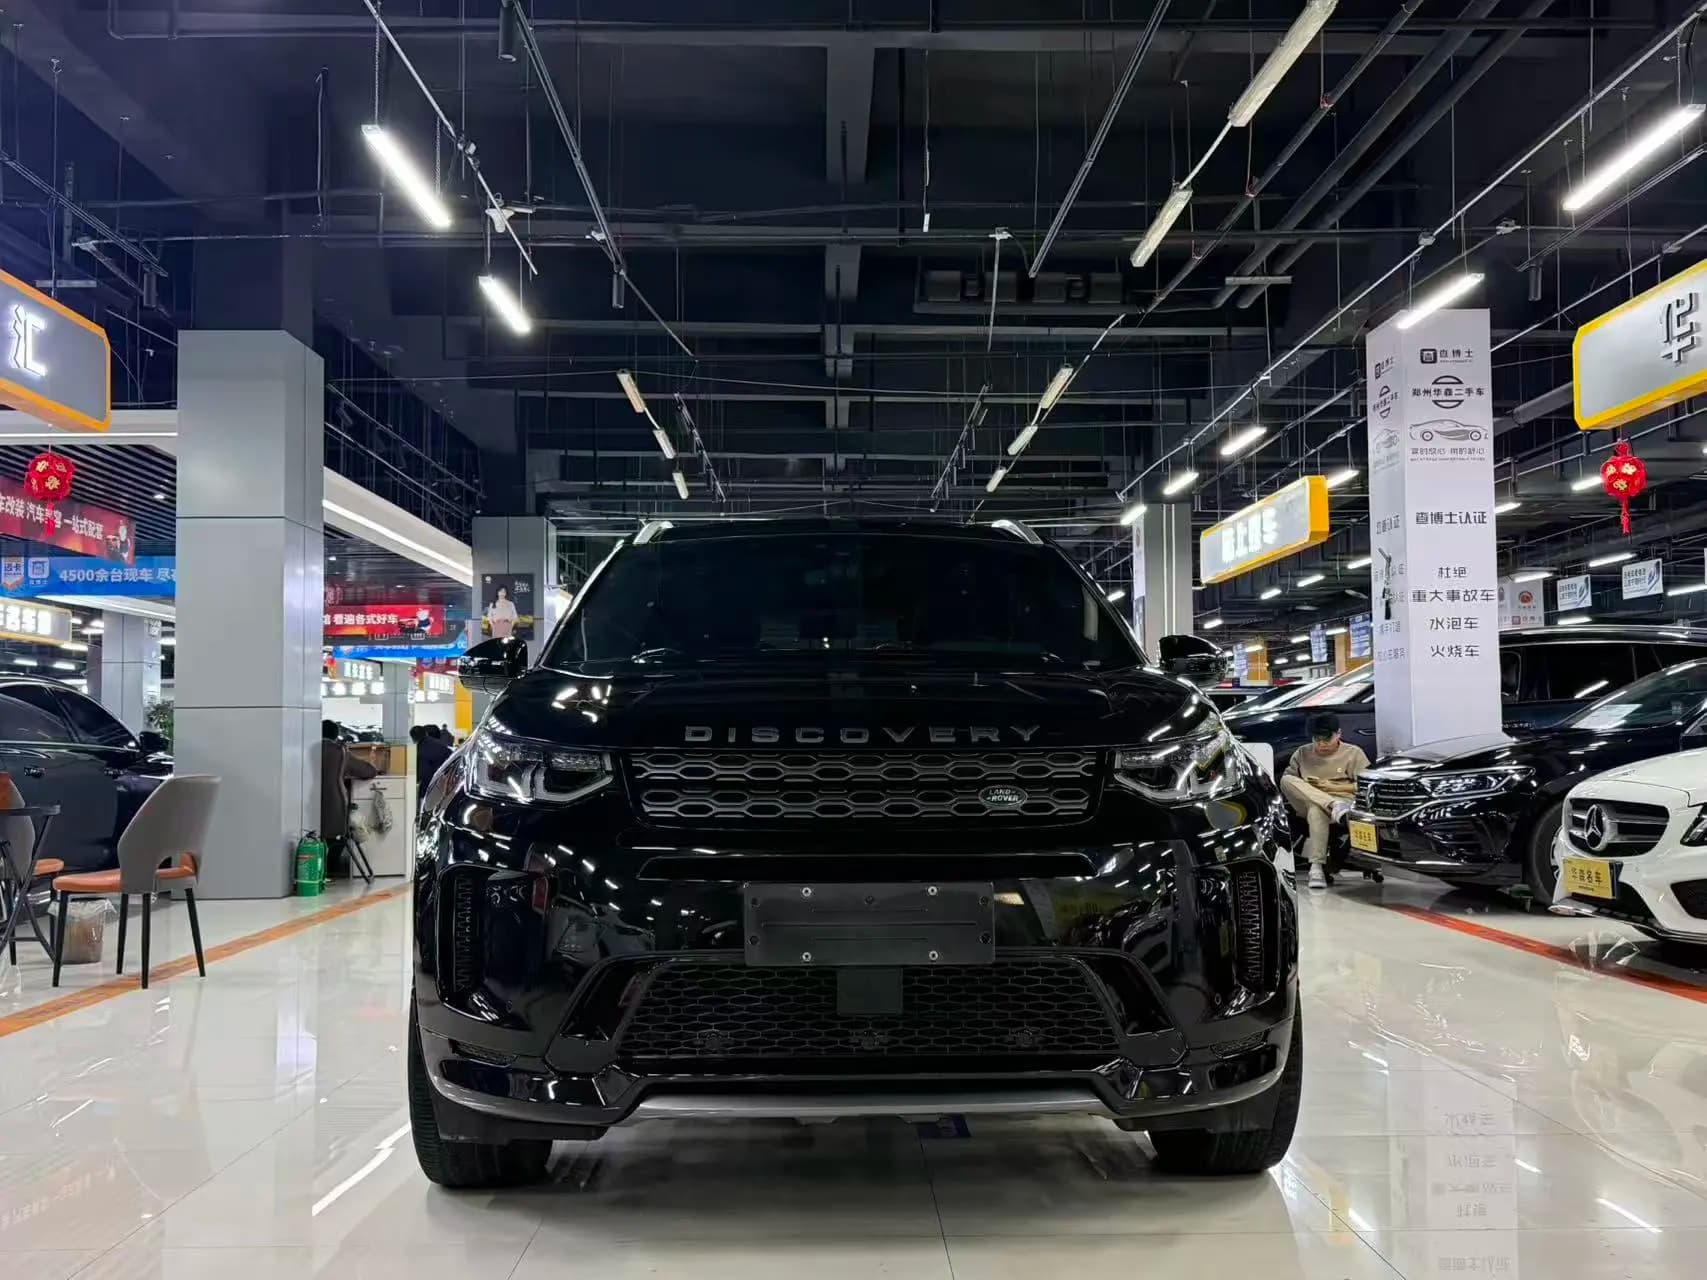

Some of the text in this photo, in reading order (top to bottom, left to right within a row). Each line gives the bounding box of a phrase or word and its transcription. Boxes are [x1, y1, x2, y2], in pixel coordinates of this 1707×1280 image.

[9, 303, 46, 377] 汇
[1415, 511, 1488, 525] 查博士认证
[59, 567, 154, 583] 4500余台现车
[1437, 566, 1468, 579] 杜绝
[1411, 589, 1496, 603] 重大事故车
[1429, 616, 1479, 630] 水泡车
[1430, 644, 1480, 658] 火烧车
[684, 725, 1041, 743] DISCOVERY
